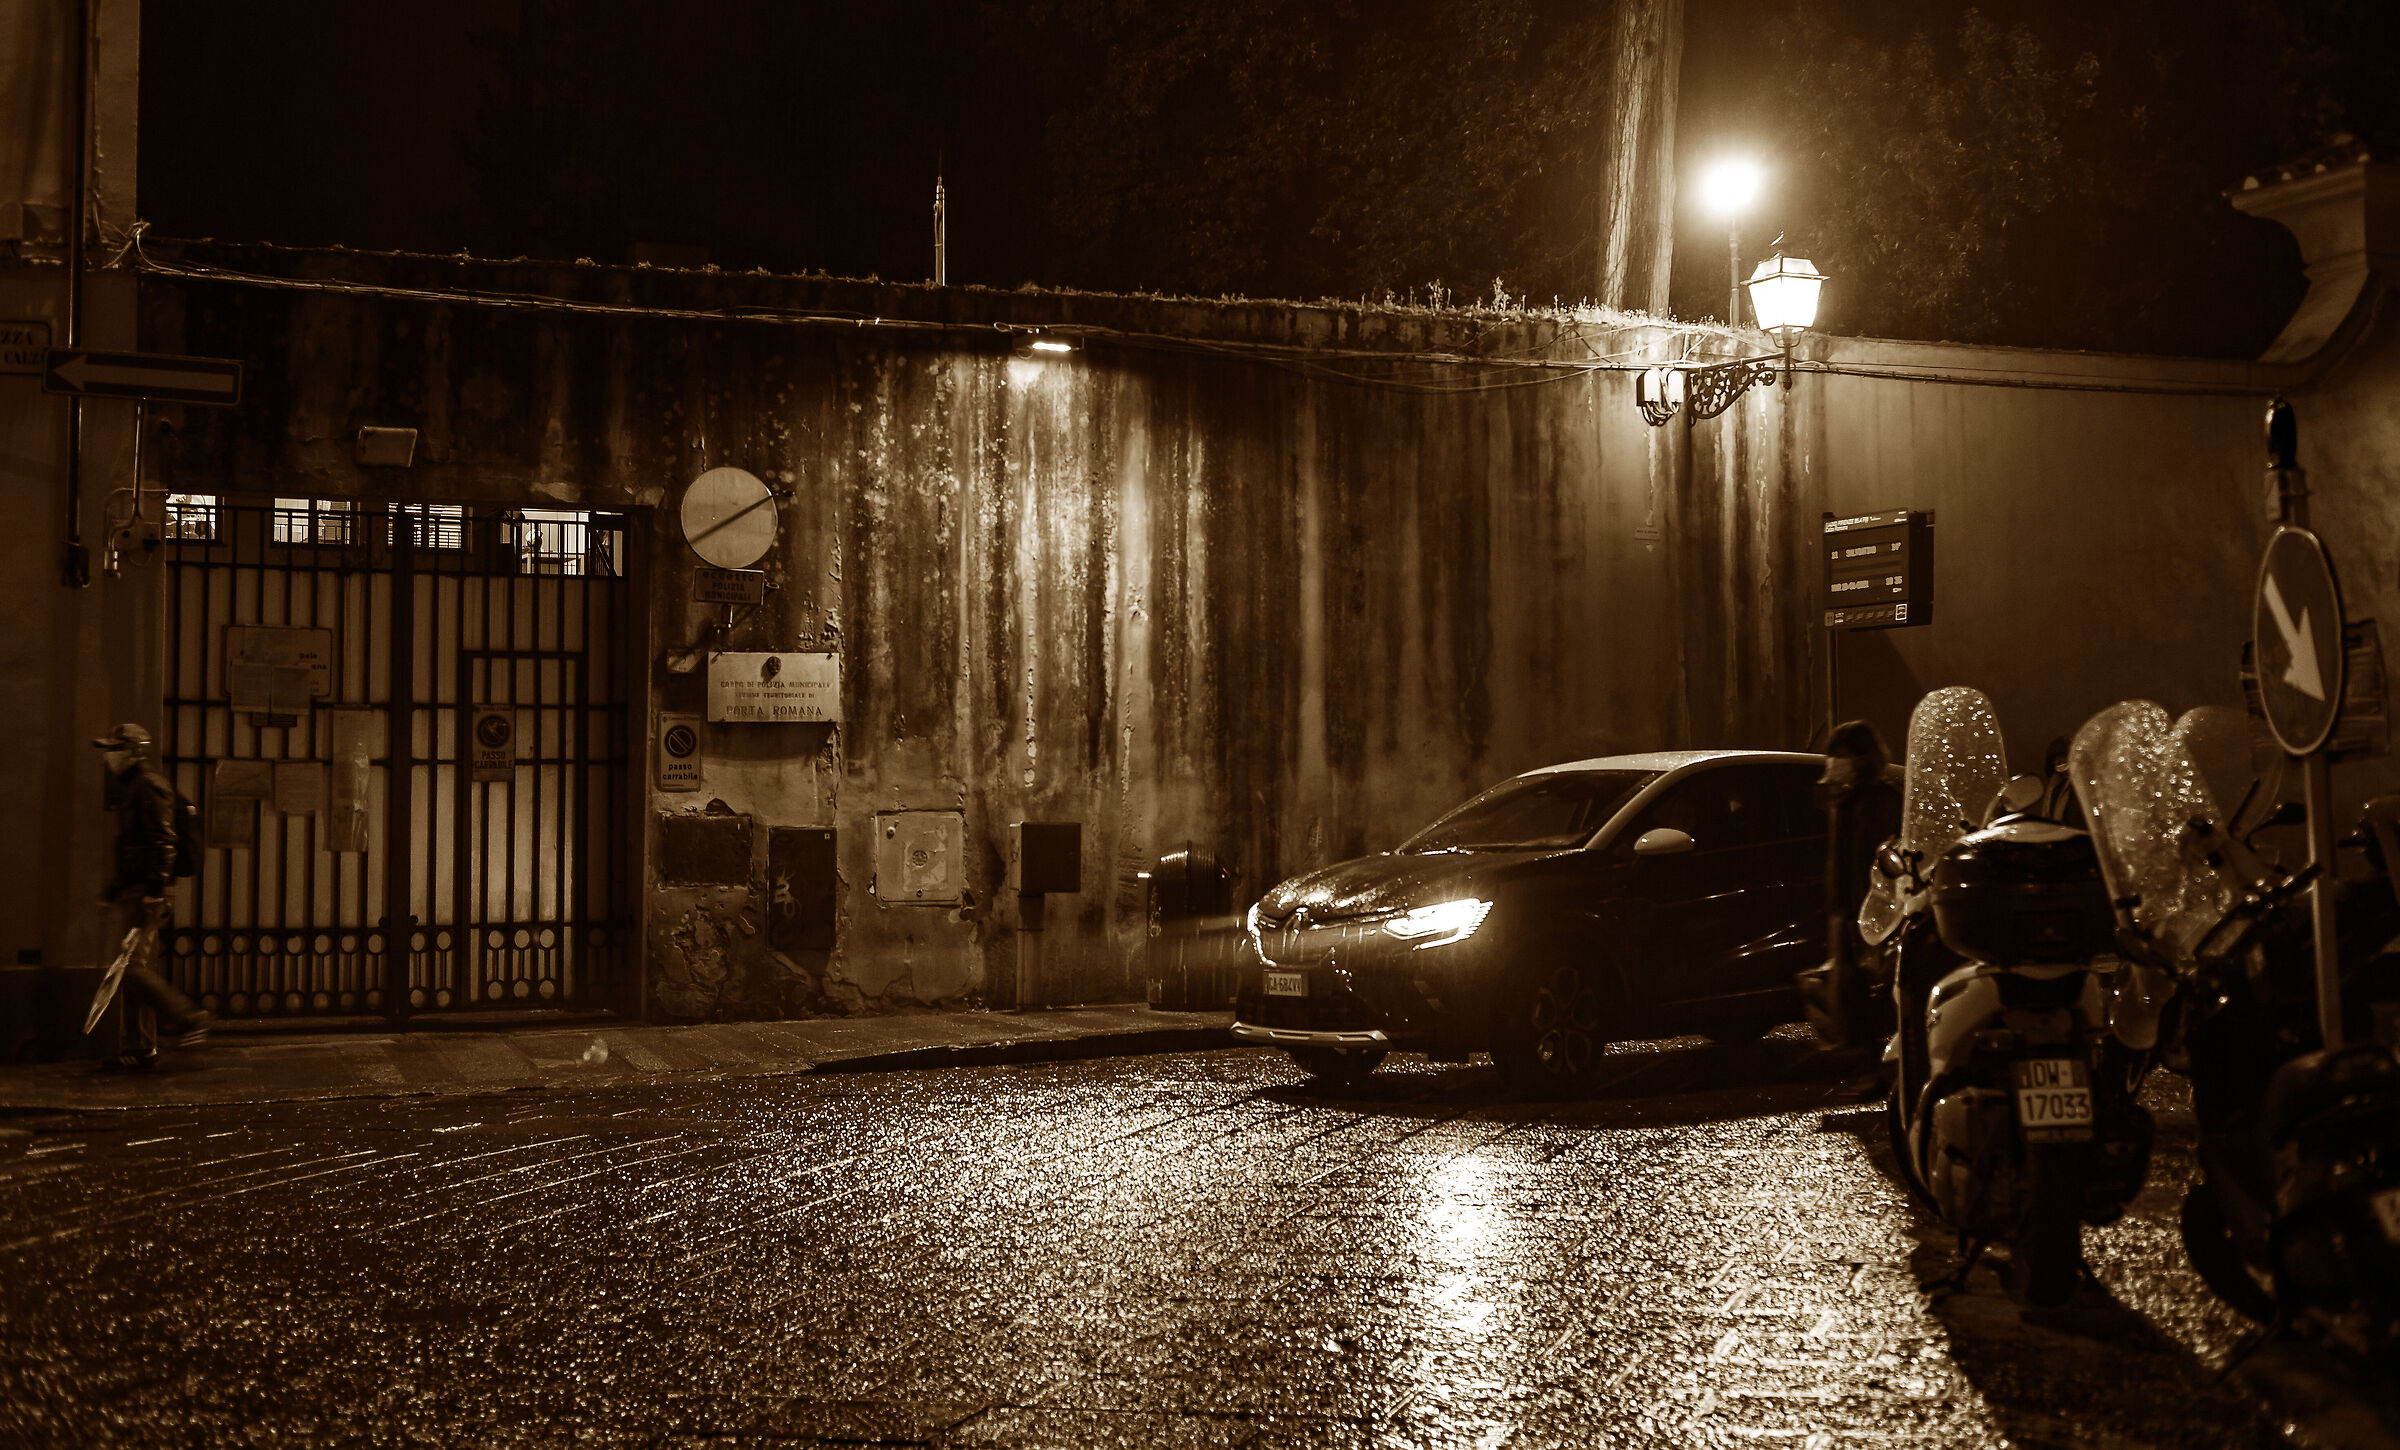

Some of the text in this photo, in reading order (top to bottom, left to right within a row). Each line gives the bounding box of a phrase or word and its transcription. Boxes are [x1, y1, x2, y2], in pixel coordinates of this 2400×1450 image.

[711, 581, 745, 592] POLIZIA
[747, 681, 755, 689] DI
[757, 681, 787, 689] POLIZIA
[788, 681, 832, 689] MUNICIPALE
[726, 704, 823, 717] PORTA ROMANA
[481, 751, 506, 761] PASSO
[668, 763, 692, 772] passo
[662, 772, 698, 781] carrabile
[2025, 1093, 2090, 1121] 17033
